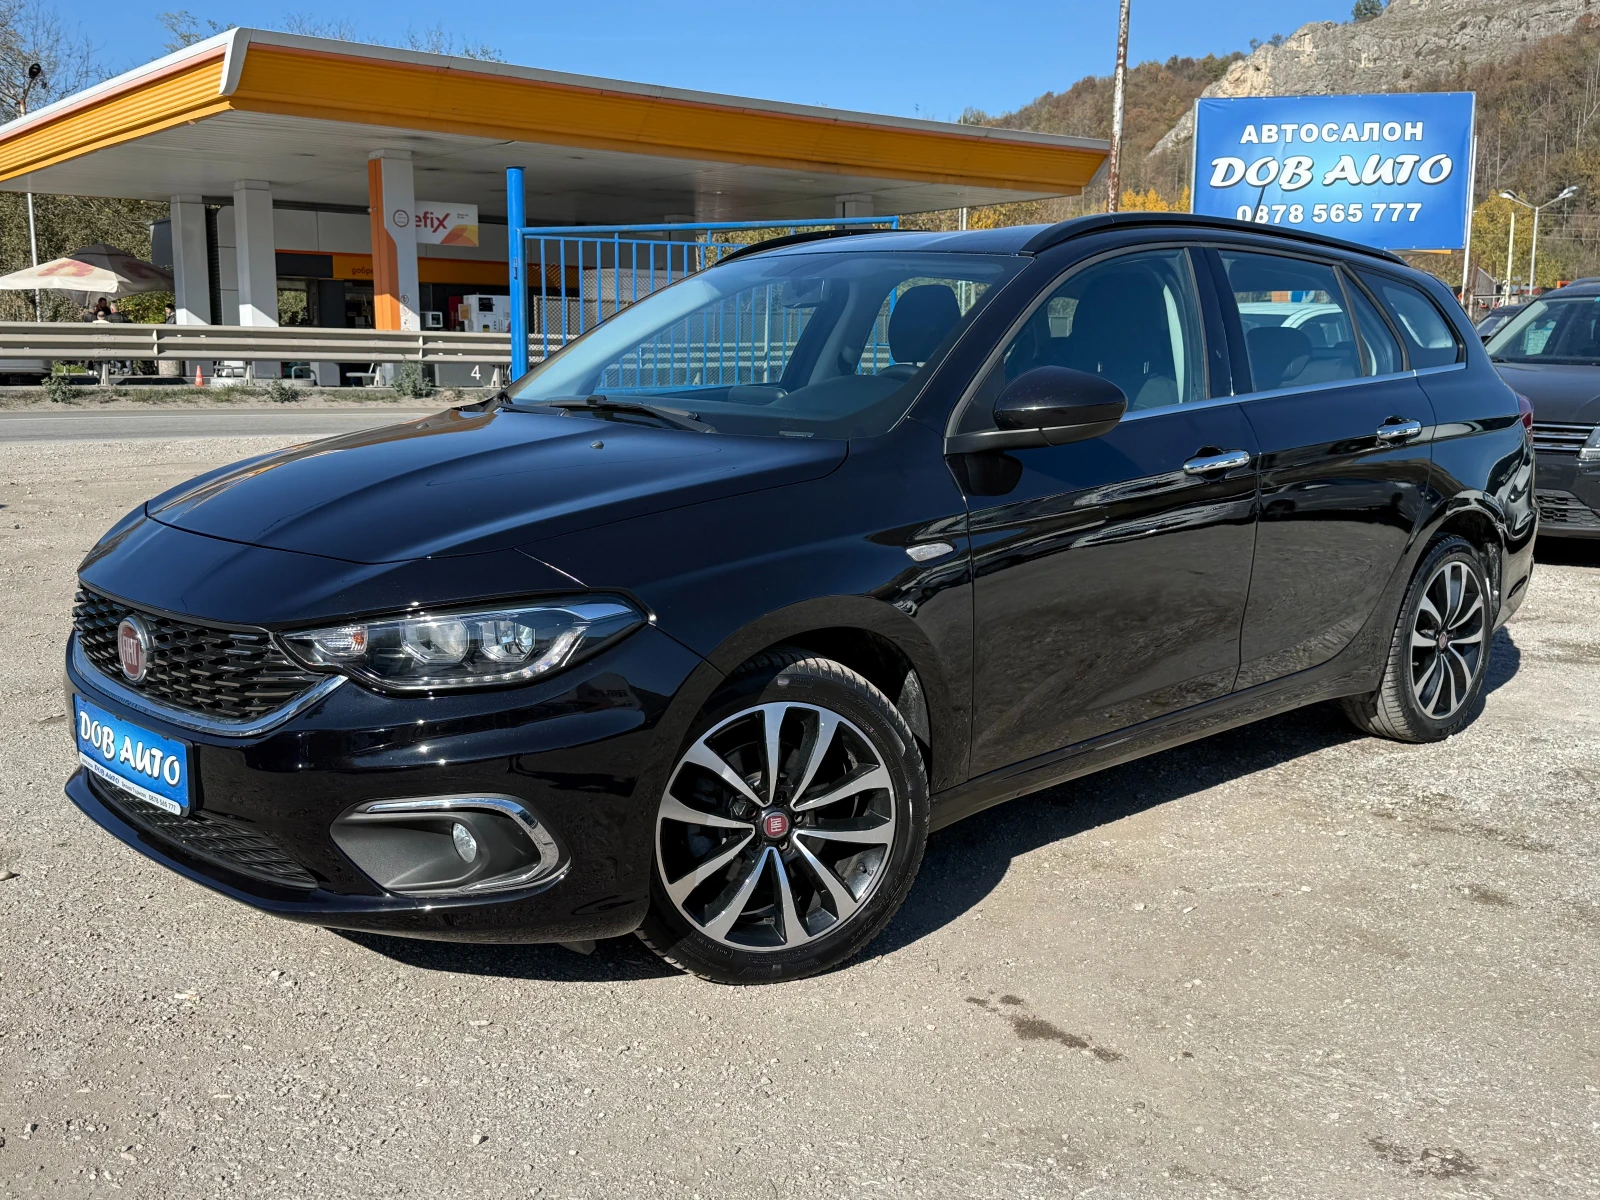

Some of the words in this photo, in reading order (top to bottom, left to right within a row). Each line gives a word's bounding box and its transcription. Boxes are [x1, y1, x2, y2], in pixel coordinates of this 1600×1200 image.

[1239, 121, 1424, 144] АВТОСАЛОН
[1209, 155, 1314, 191] DOB
[1322, 153, 1453, 185] AUTO
[1236, 204, 1304, 224] 0878
[1312, 203, 1363, 223] 565
[1371, 203, 1422, 222] 777
[470, 364, 481, 381] 4
[122, 635, 138, 667] FIAT
[79, 711, 115, 759] DOB
[120, 735, 181, 787] AUTO
[770, 817, 782, 832] FIAT
